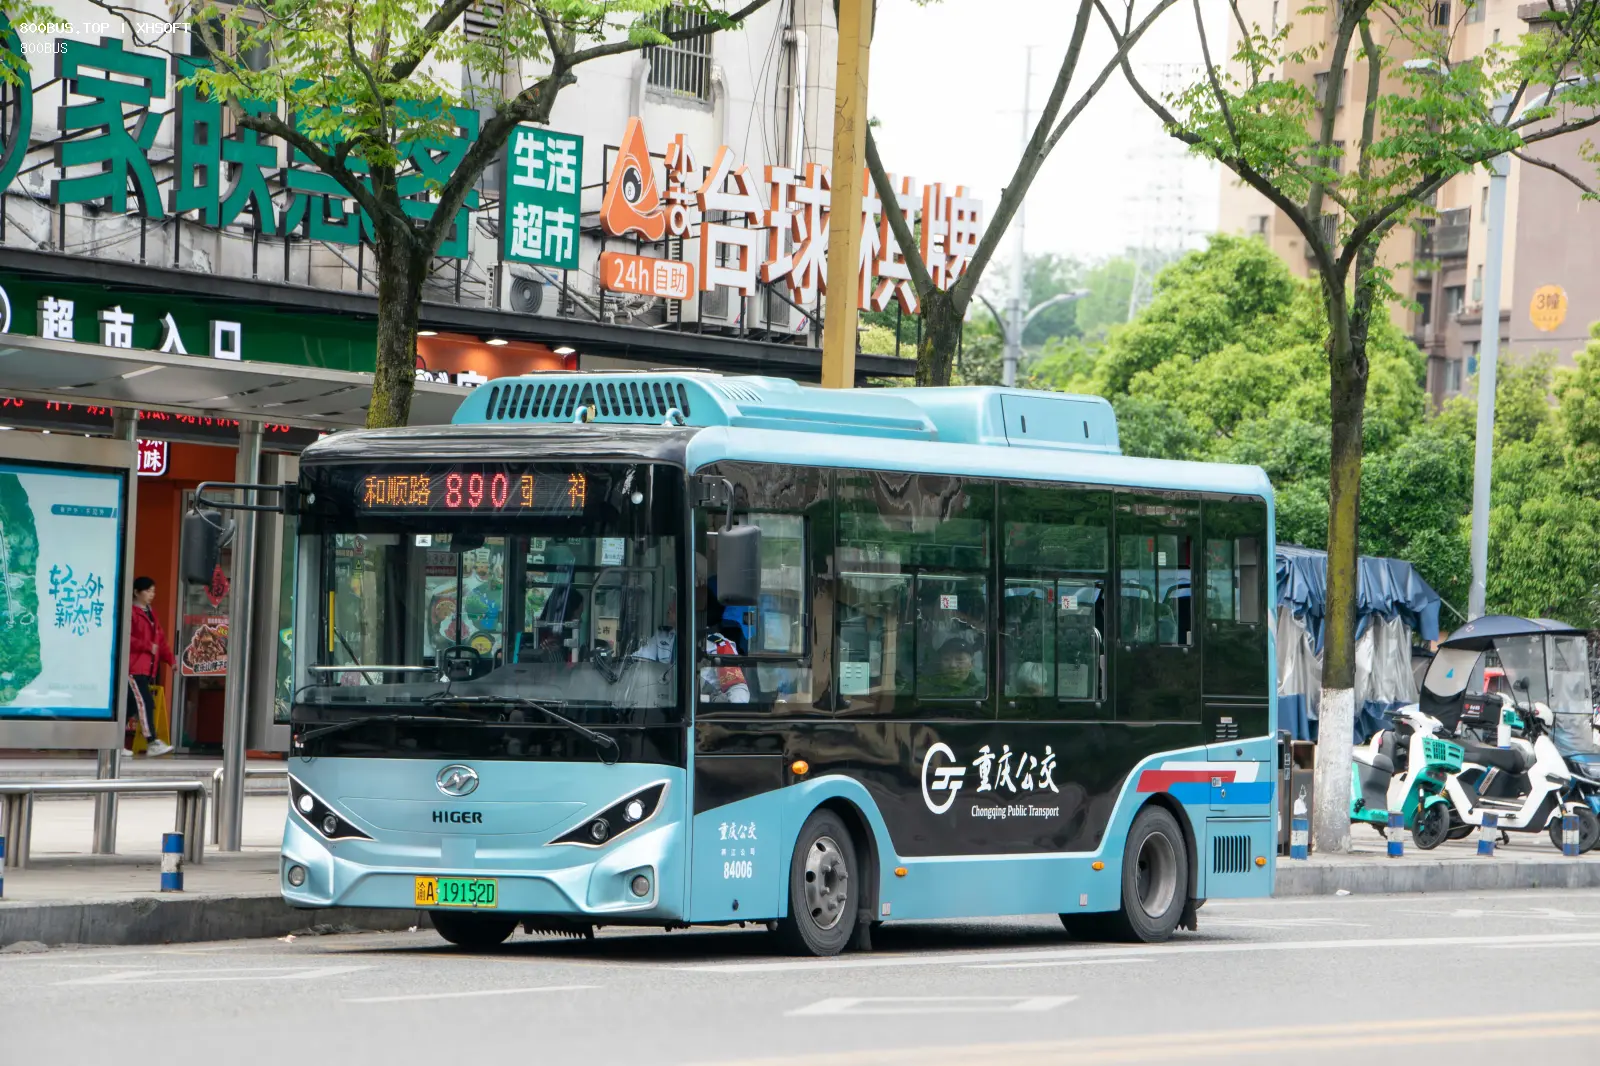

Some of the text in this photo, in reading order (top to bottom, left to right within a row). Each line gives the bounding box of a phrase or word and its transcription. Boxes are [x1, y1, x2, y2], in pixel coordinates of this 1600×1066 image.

[513, 131, 577, 195] 生活
[510, 201, 576, 263] 超市
[698, 146, 983, 321] 台球棋牌
[614, 258, 686, 294] 24h 自助
[37, 296, 241, 361] 超市入口
[364, 474, 431, 508] 和顺路
[446, 473, 507, 508] 890
[49, 564, 104, 606] 轻户外
[54, 598, 104, 636] 新态度
[972, 744, 1059, 793] 重庆公交
[432, 811, 483, 824] HIGER
[971, 805, 1060, 819] Chongqing Public Transport
[718, 822, 757, 841] 重庆公交
[723, 860, 753, 879] 84006
[443, 882, 495, 904] 19152D
